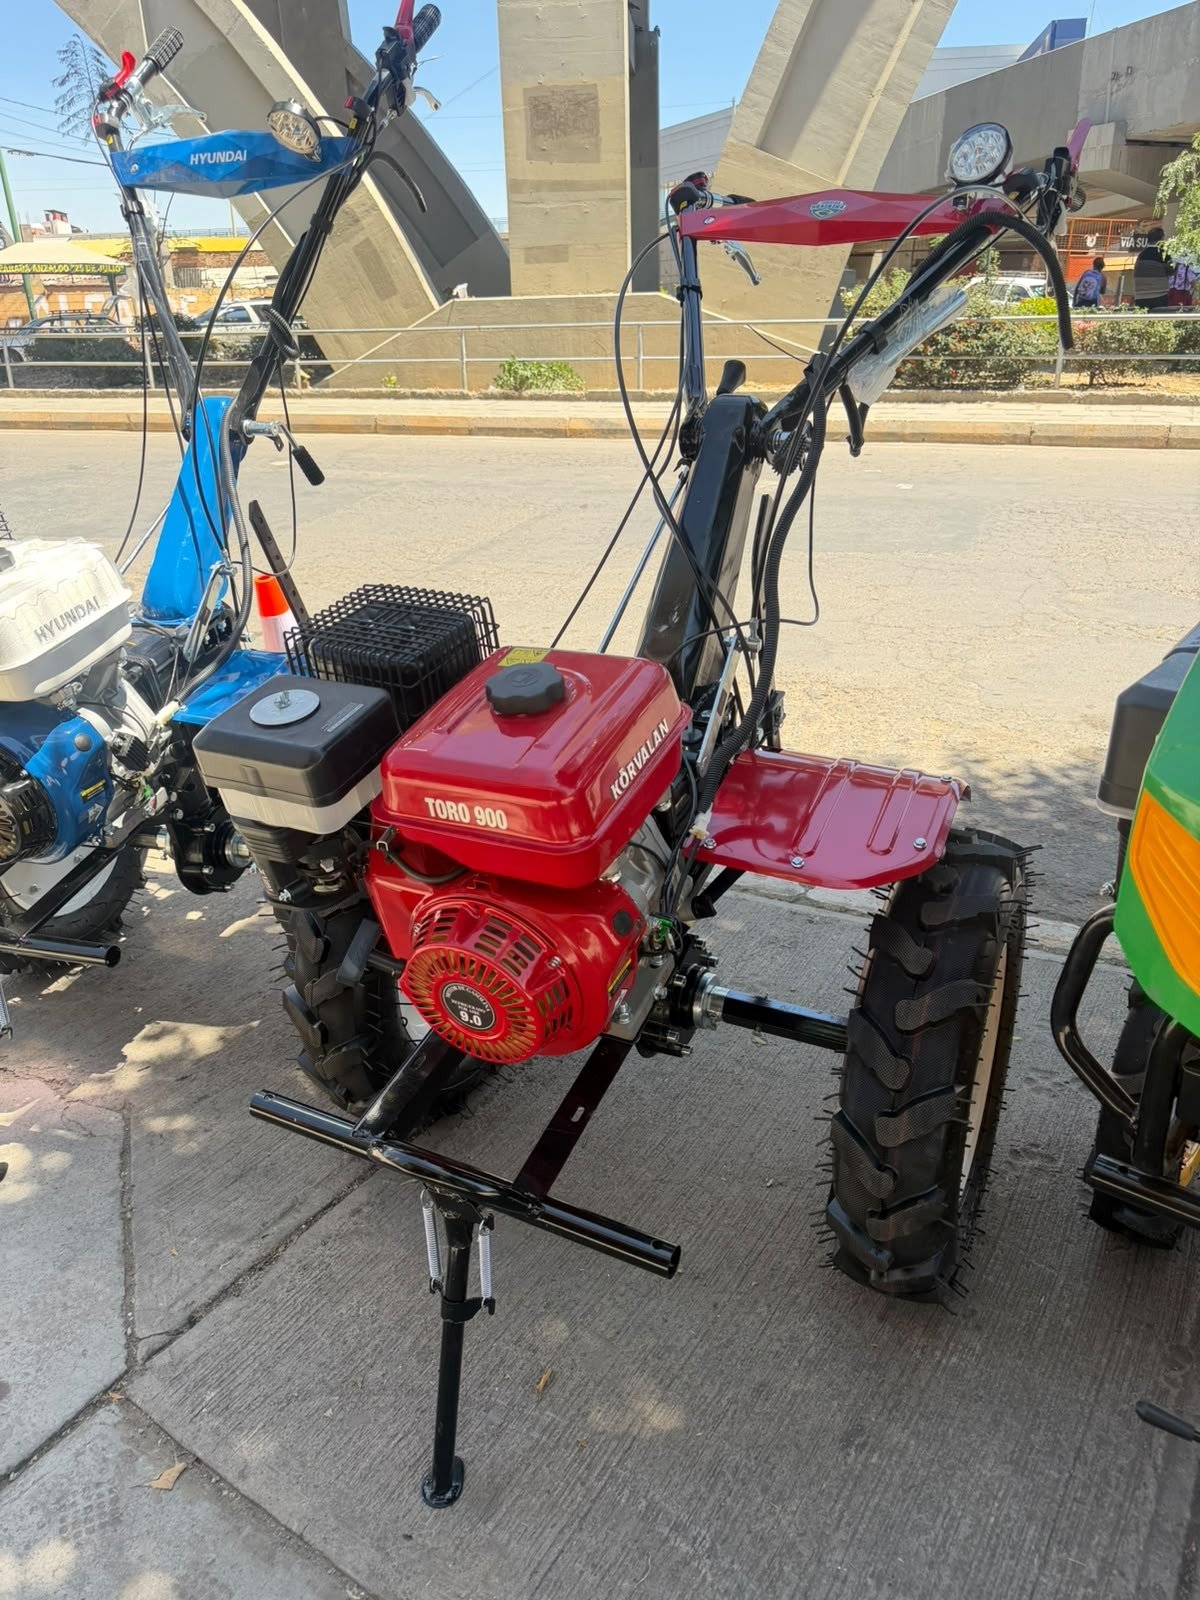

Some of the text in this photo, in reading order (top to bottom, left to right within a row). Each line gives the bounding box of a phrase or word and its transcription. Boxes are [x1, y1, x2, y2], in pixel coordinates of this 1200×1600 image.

[190, 150, 247, 165] HYUNDAI
[33, 595, 101, 643] HYUNDAI
[424, 797, 508, 831] TORO 900
[460, 1010, 482, 1026] 9.0
